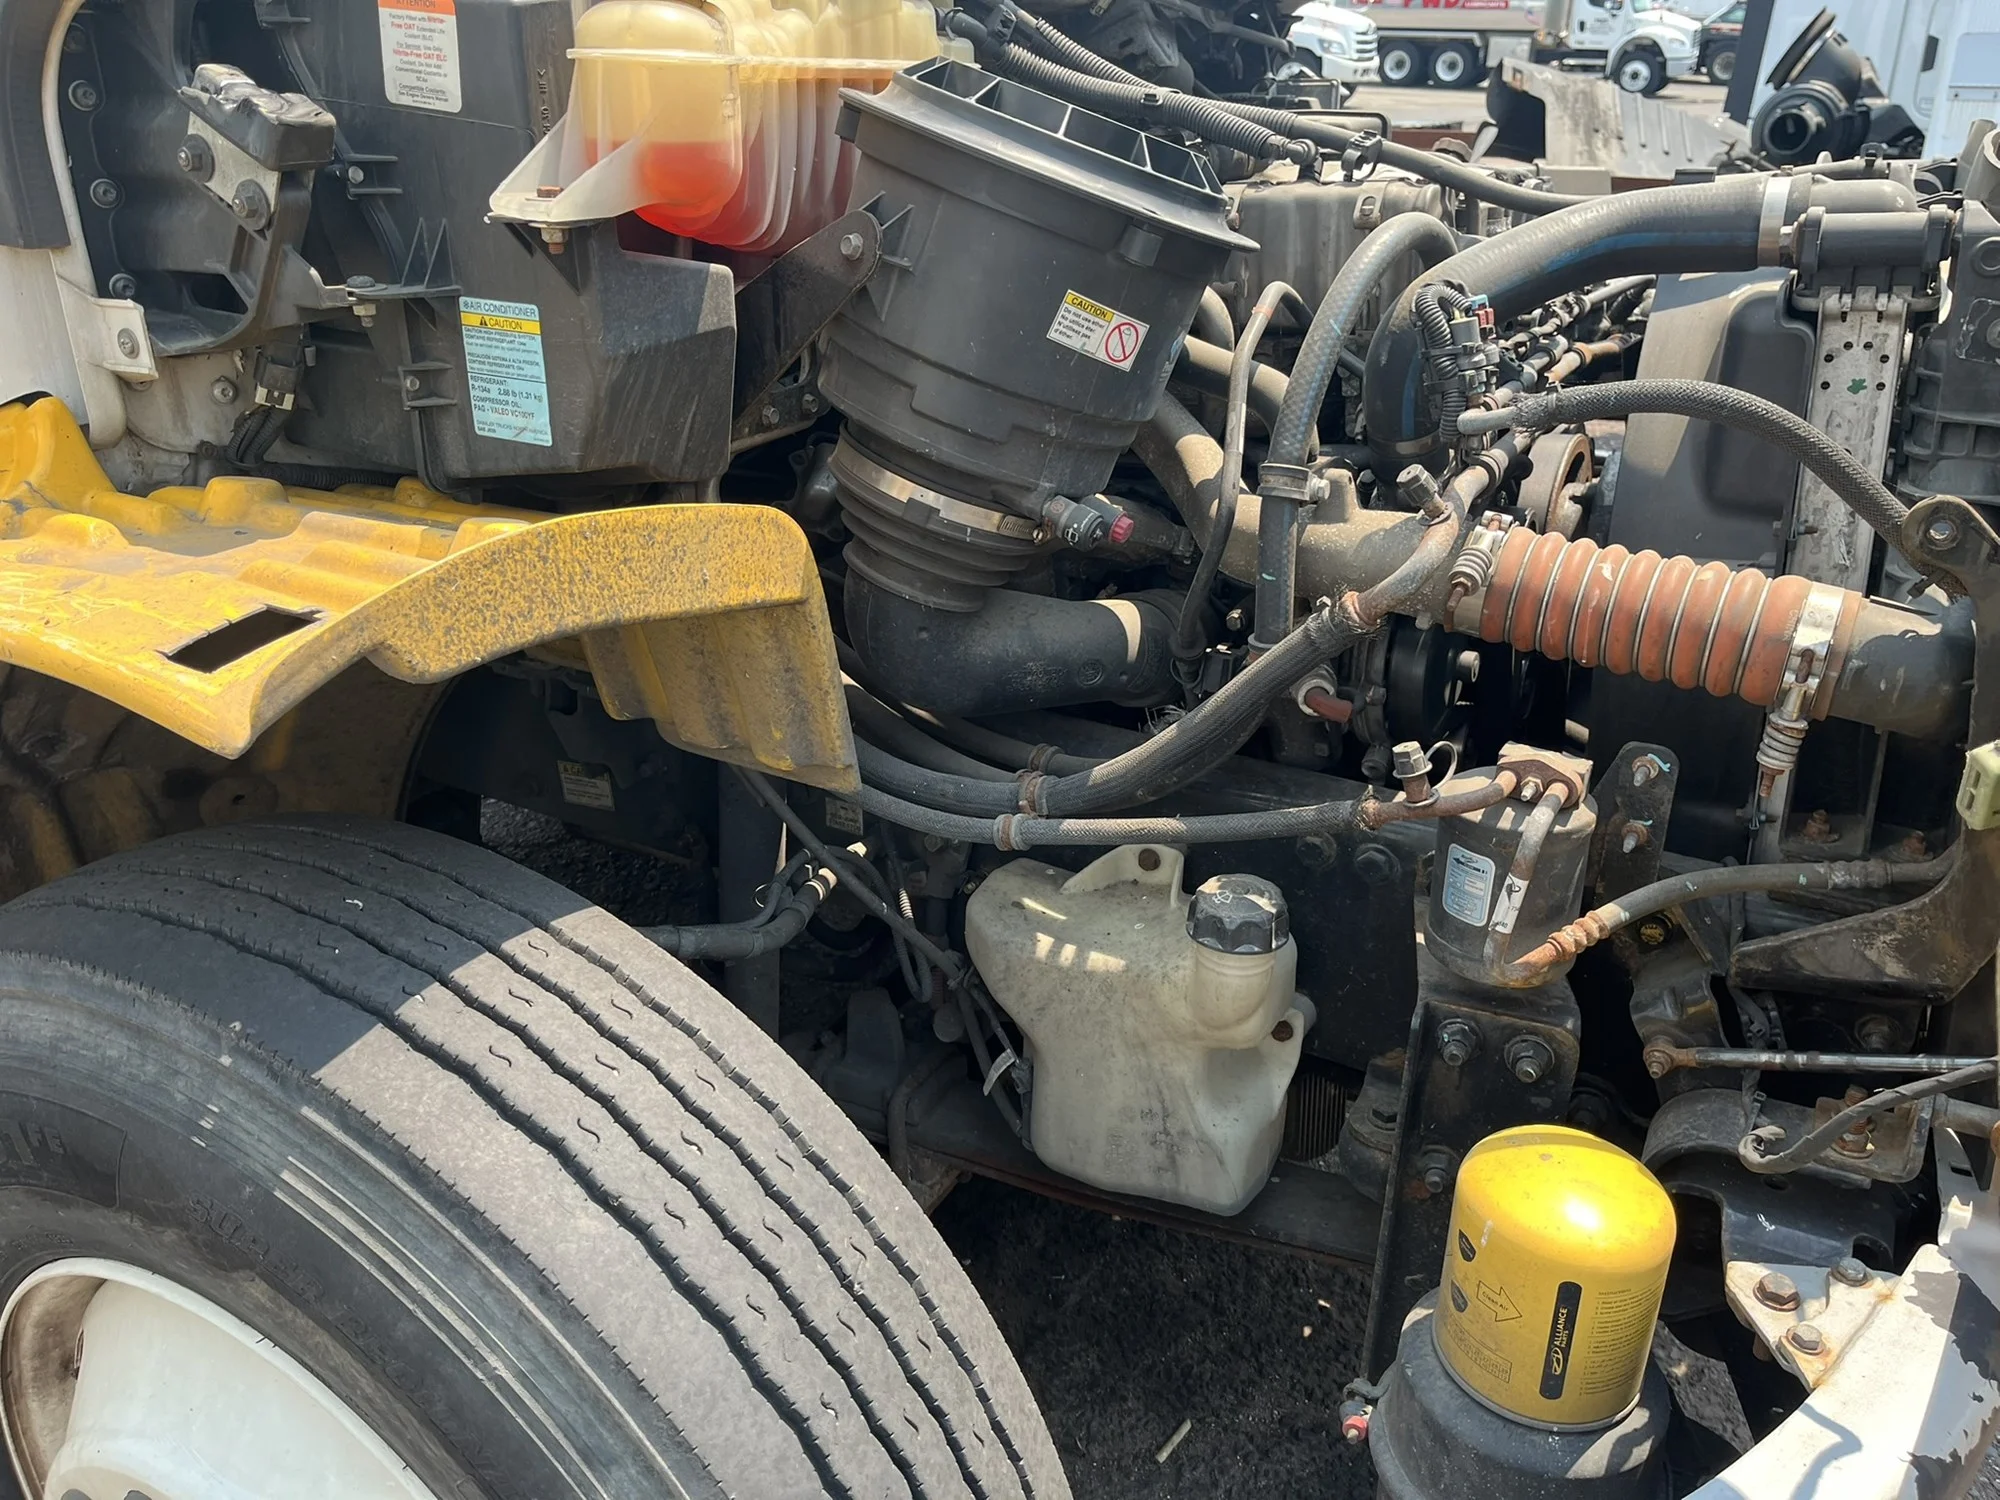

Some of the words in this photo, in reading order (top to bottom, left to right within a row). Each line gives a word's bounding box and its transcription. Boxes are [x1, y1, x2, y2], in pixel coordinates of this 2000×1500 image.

[396, 0, 436, 8] ATTENTION
[469, 301, 482, 311] AIR
[483, 303, 536, 318] CONDITIONER
[1071, 297, 1108, 319] CAUTION
[489, 318, 522, 330] CAUTION
[1063, 306, 1072, 314] Do
[1072, 310, 1081, 318] not
[1081, 315, 1092, 323] use
[1091, 318, 1105, 329] ether
[470, 375, 509, 387] REFRIGERANT:
[471, 384, 491, 394] R-134a
[511, 390, 517, 398] lb
[472, 395, 510, 407] COMPRESSOR
[490, 406, 509, 416] VALEO
[496, 422, 512, 430] TRUCKS
[1481, 1291, 1499, 1305] Clean
[1499, 1303, 1509, 1312] Air
[1553, 1306, 1568, 1347] ALLIANCE
[1561, 1330, 1569, 1348] PARTS
